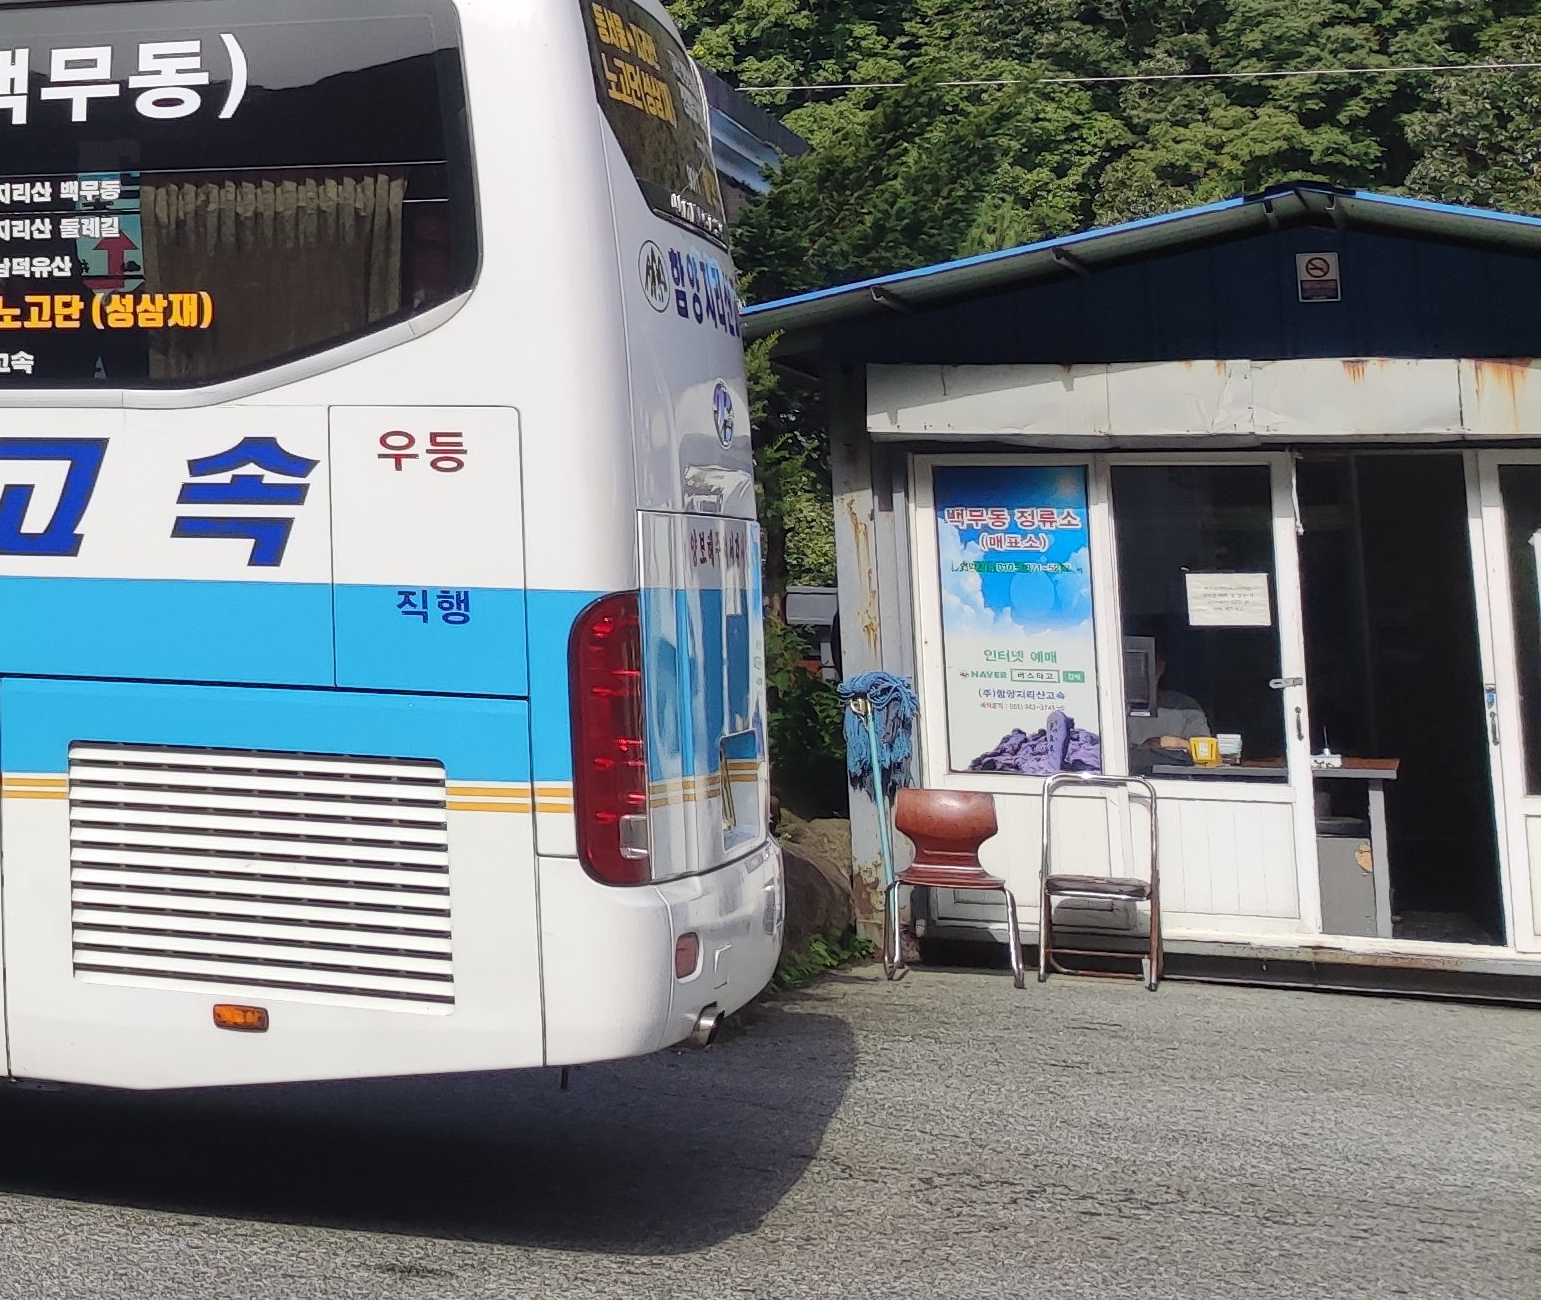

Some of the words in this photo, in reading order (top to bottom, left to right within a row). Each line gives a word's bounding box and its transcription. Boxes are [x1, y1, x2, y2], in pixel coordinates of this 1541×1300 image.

[60, 180, 122, 202] 백무동
[59, 216, 121, 239] 둘레길
[92, 291, 214, 330] (성삼재)
[377, 430, 469, 473] 우등
[945, 507, 1009, 530] 백무동
[1015, 507, 1082, 530] 정류소
[397, 589, 471, 627] 직행
[984, 649, 1024, 663] 인터넷
